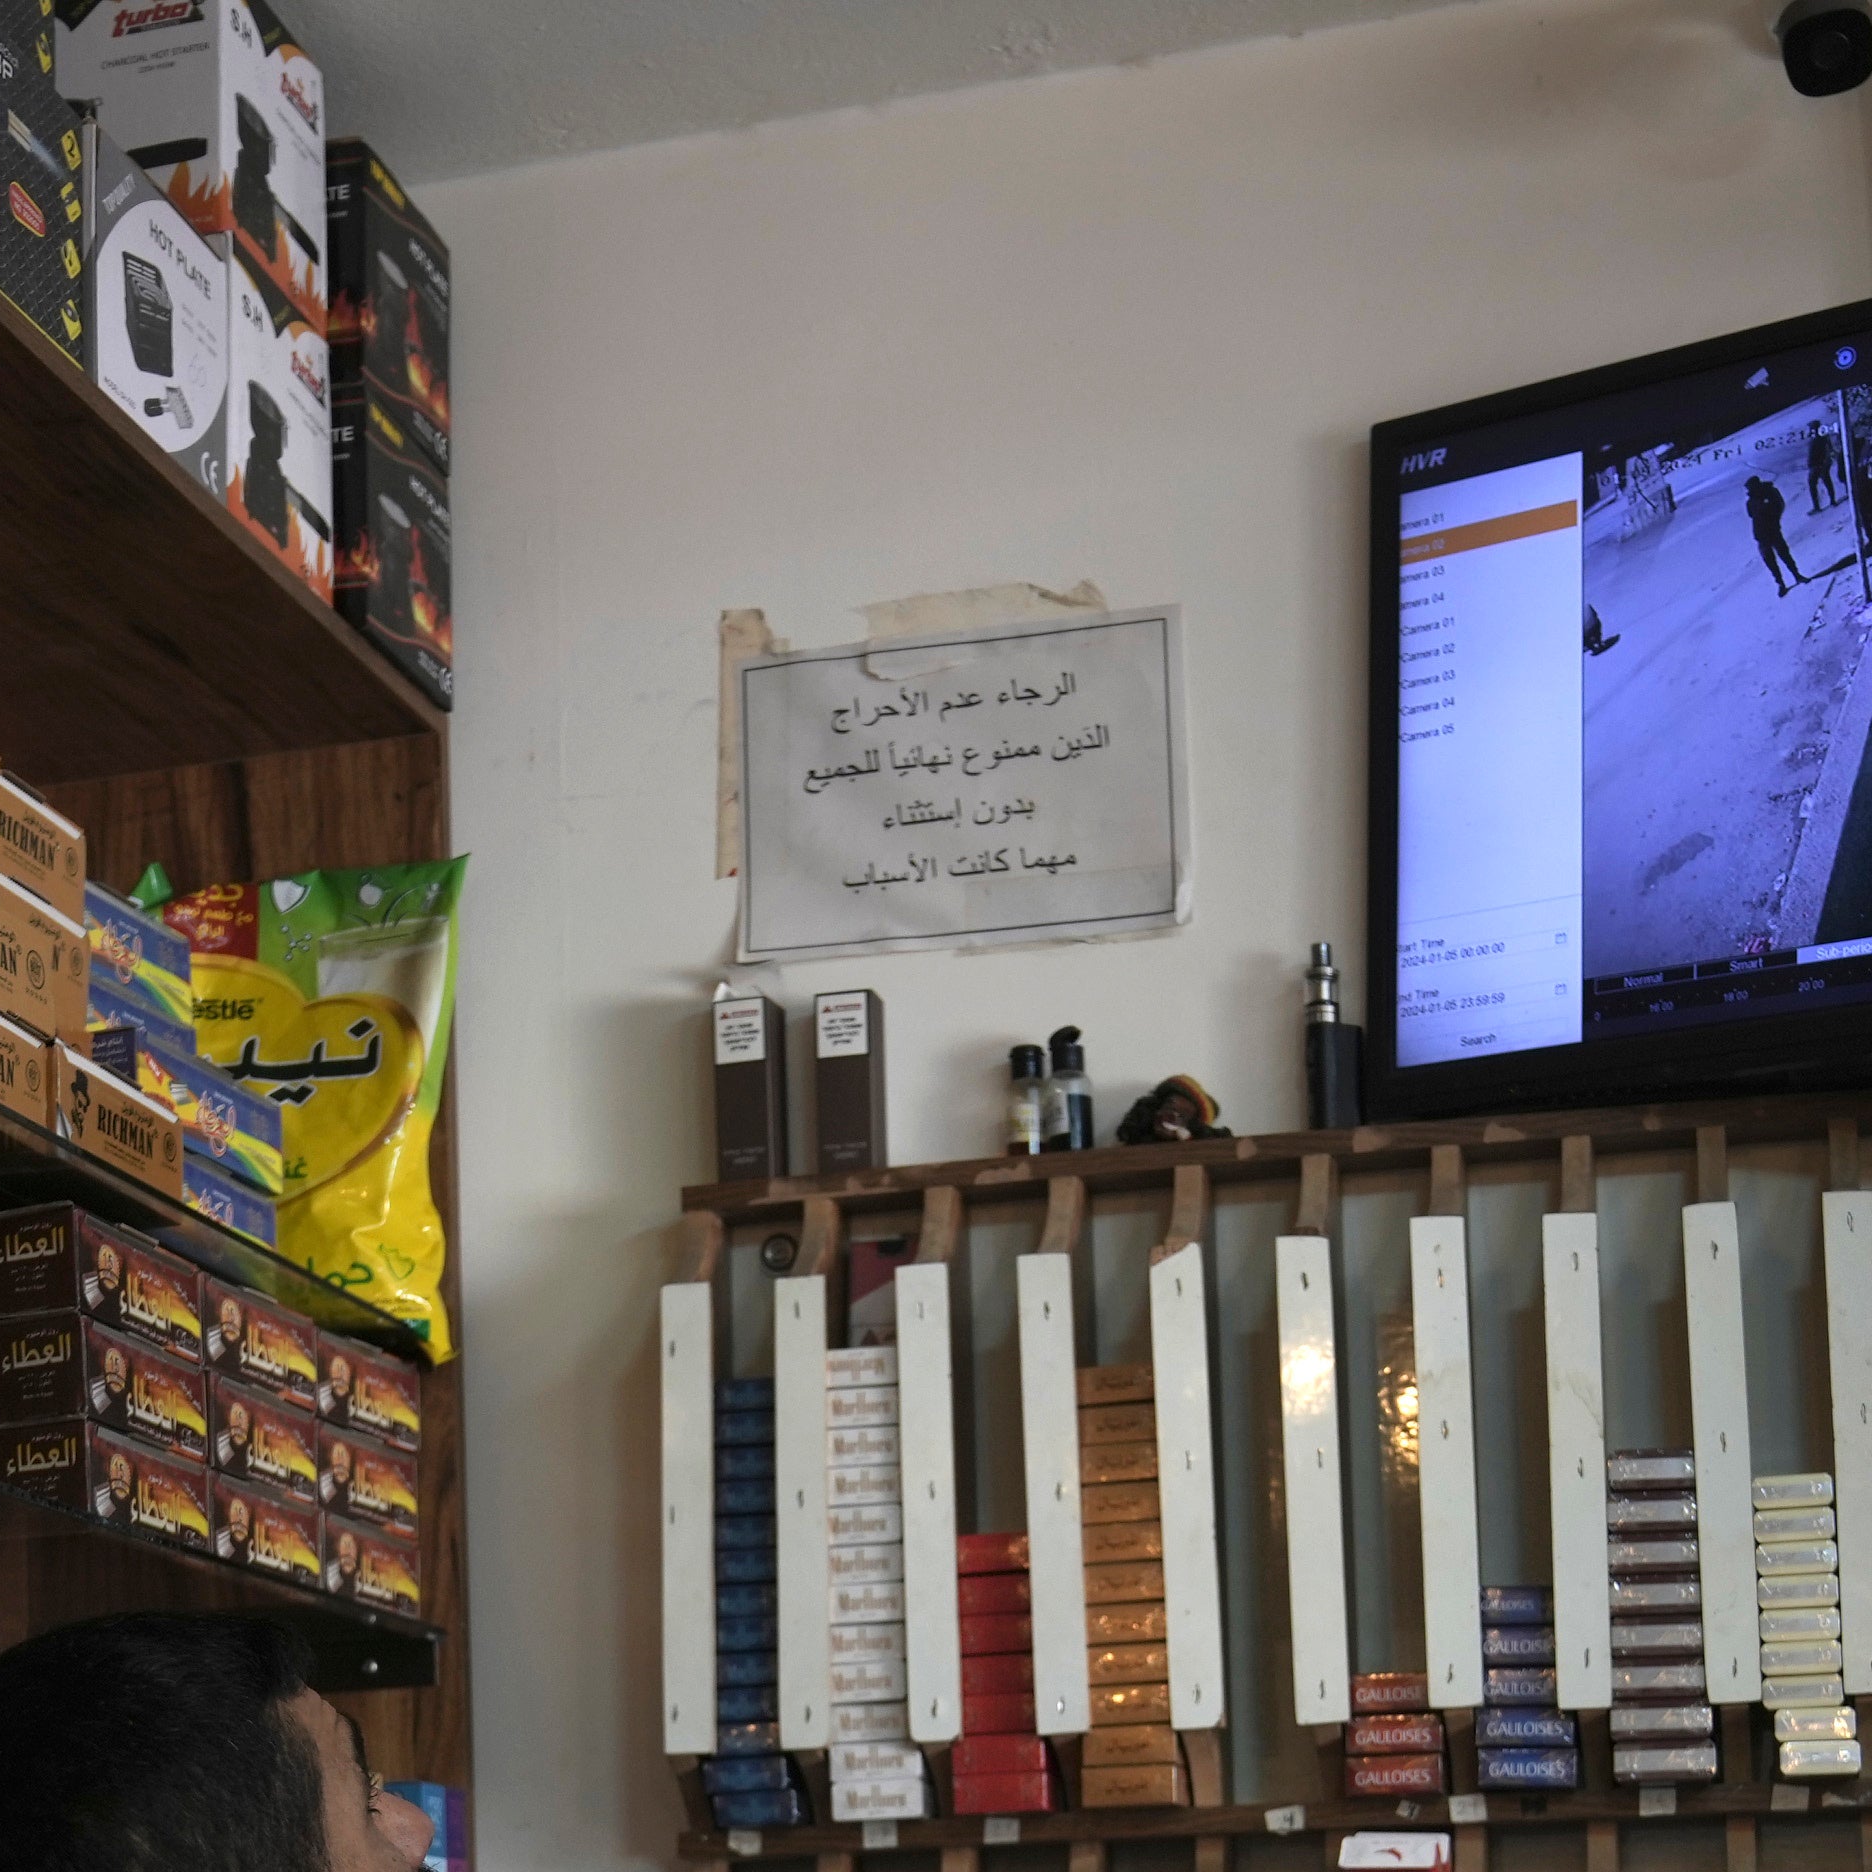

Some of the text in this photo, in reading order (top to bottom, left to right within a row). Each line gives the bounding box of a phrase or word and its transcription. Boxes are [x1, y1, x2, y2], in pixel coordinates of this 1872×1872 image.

[149, 219, 213, 300] HOT PLATE
[1400, 448, 1448, 476] HVR
[997, 671, 1076, 706] الرجاء
[939, 692, 983, 723] عدم
[802, 749, 880, 795] للجميع
[962, 739, 1042, 777] ممنوع
[972, 798, 1036, 826] بدون
[842, 848, 1077, 894] مهما كانت الأسباب
[1624, 972, 1663, 988] Normal
[1729, 956, 1764, 973] Smart
[1460, 1034, 1496, 1048] Search
[97, 1103, 154, 1159] RICHMAN
[2, 1332, 72, 1375] العطاء
[1355, 1770, 1430, 1786] GAULOISES
[1489, 1760, 1565, 1778] GAULOISES
